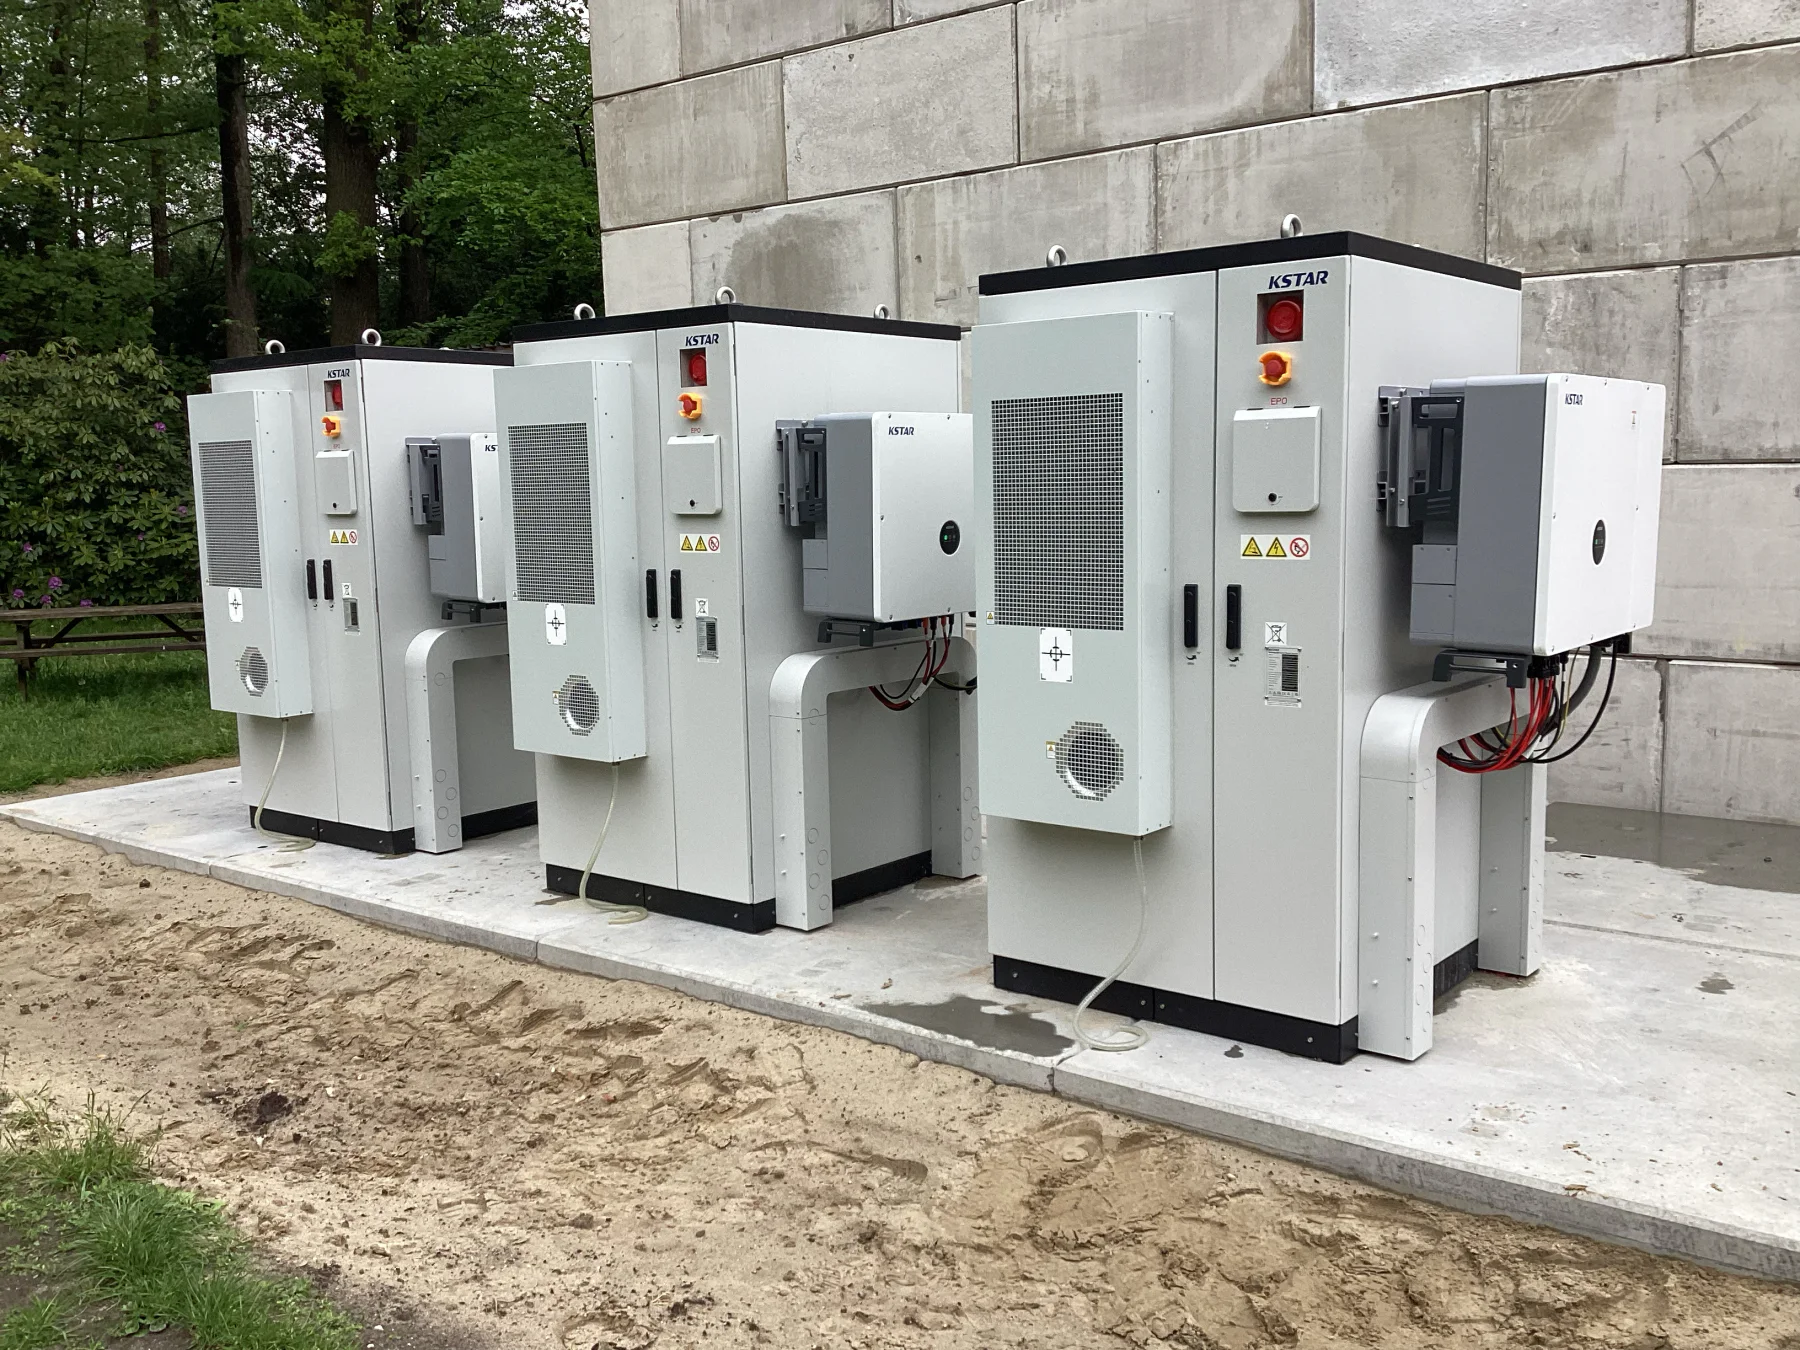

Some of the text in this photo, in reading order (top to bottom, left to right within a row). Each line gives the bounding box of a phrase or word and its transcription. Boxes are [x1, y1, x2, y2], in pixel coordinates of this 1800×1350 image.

[1268, 270, 1329, 289] KSTAR
[685, 333, 719, 346] KSTAR
[327, 368, 350, 379] KSTAR
[1270, 397, 1288, 405] EPO
[1565, 393, 1583, 405] KSTAR
[888, 426, 915, 436] KSTAR
